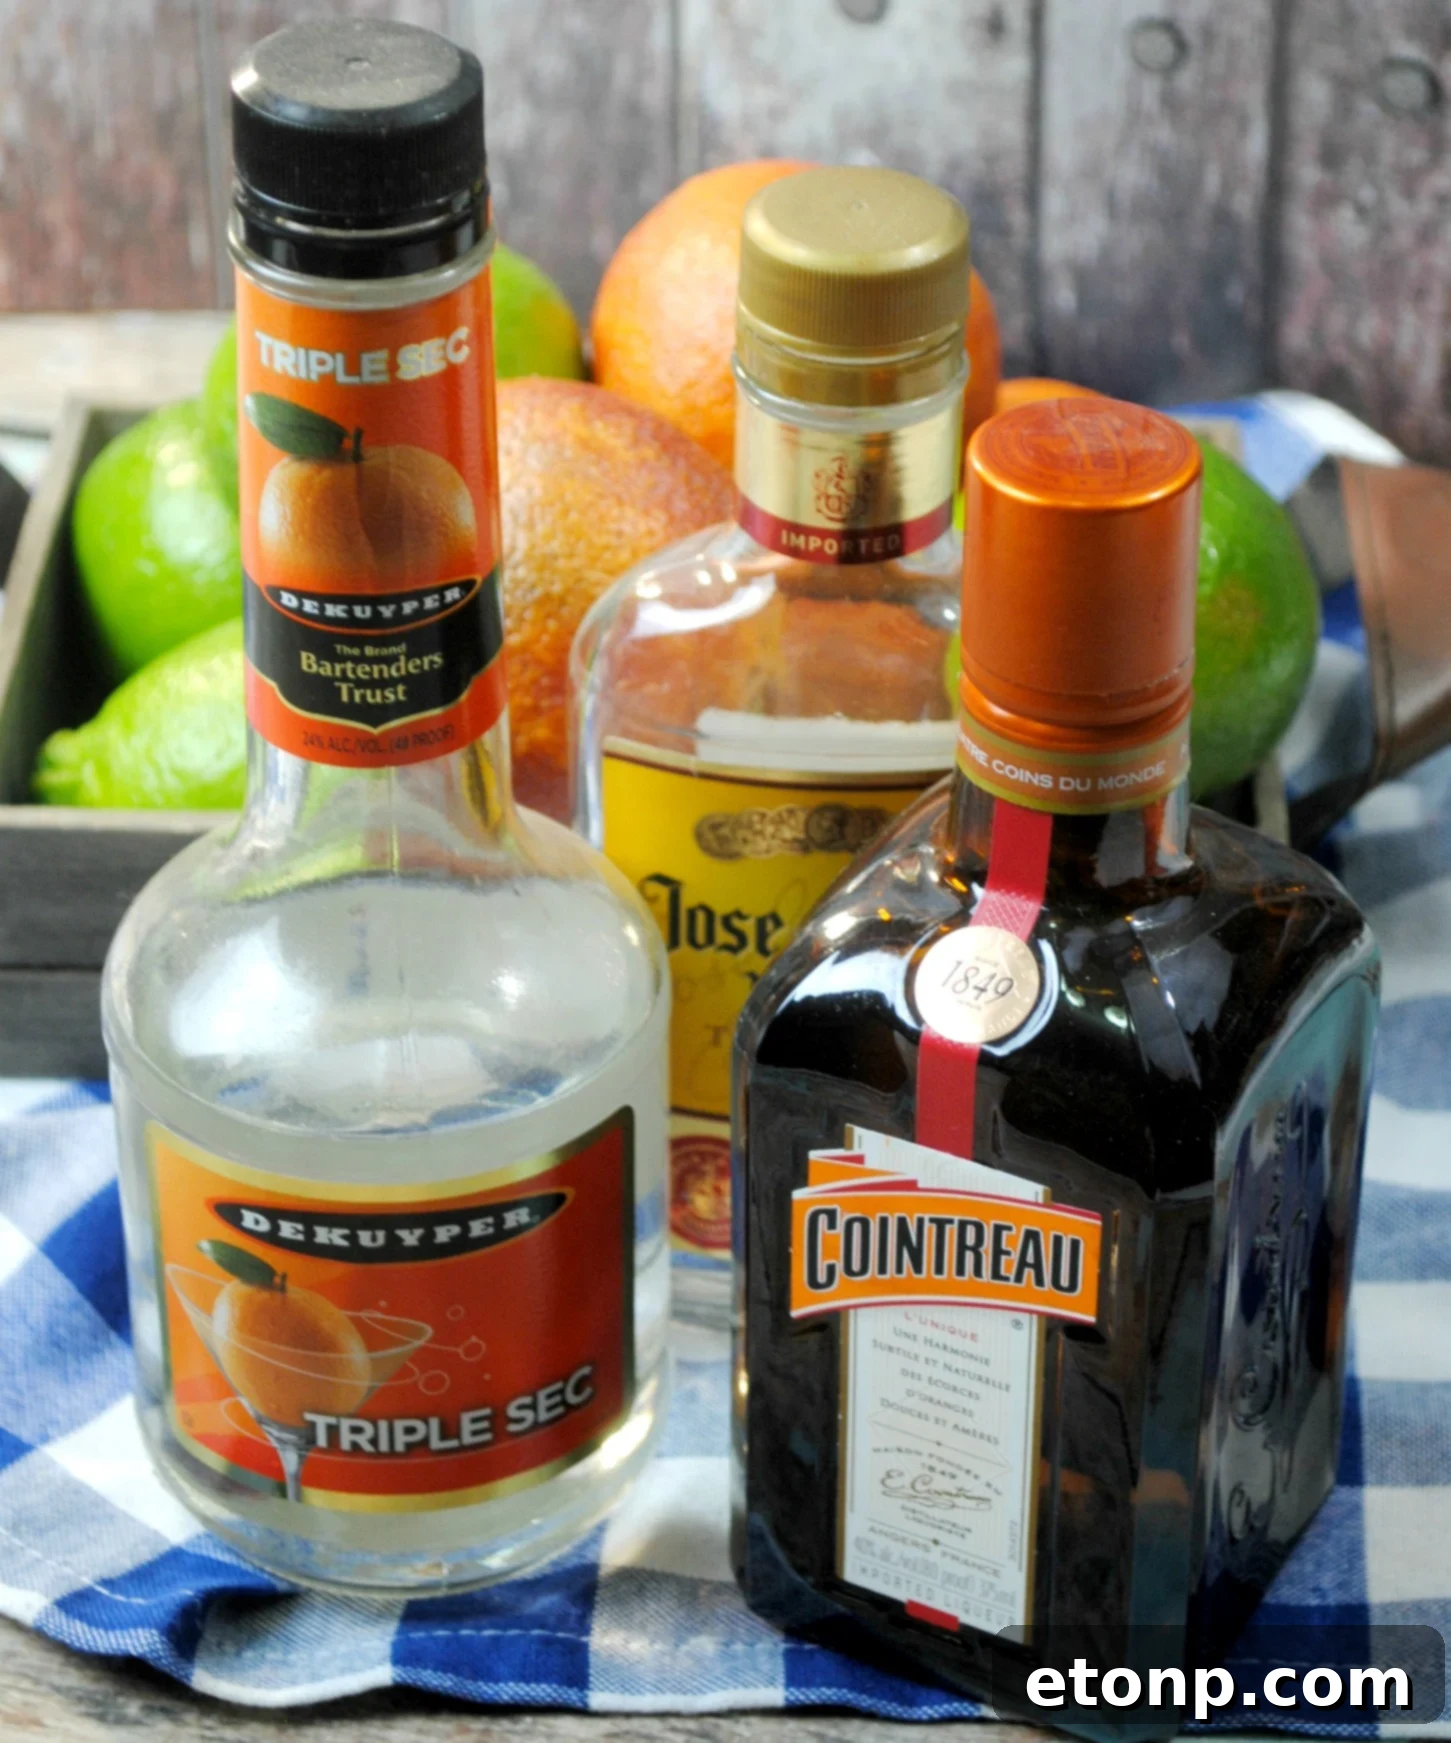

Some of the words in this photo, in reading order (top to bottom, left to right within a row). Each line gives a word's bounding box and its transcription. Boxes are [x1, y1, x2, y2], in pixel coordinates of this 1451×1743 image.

[255, 330, 388, 385] TRIPLE
[396, 326, 470, 381] SEC
[781, 530, 900, 555] IMPORTED
[279, 586, 463, 619] DEKUYPER
[300, 650, 443, 681] Bartenders
[334, 643, 361, 657] The
[364, 642, 407, 657] Brand
[334, 681, 407, 704] Trust
[992, 758, 1053, 790] COINS
[1059, 777, 1090, 792] DU
[1098, 760, 1166, 790] MONDE
[640, 874, 783, 957] Jose
[941, 959, 1015, 1004] 1849
[241, 1207, 531, 1247] DEKUYPER
[805, 1203, 1083, 1296] COINTREAU
[904, 1311, 979, 1343] L'UNIQUE
[893, 1326, 918, 1343] UNE
[924, 1336, 991, 1367] HARMONIE
[304, 1408, 492, 1452] TRIPLE
[506, 1366, 595, 1433] SEC
